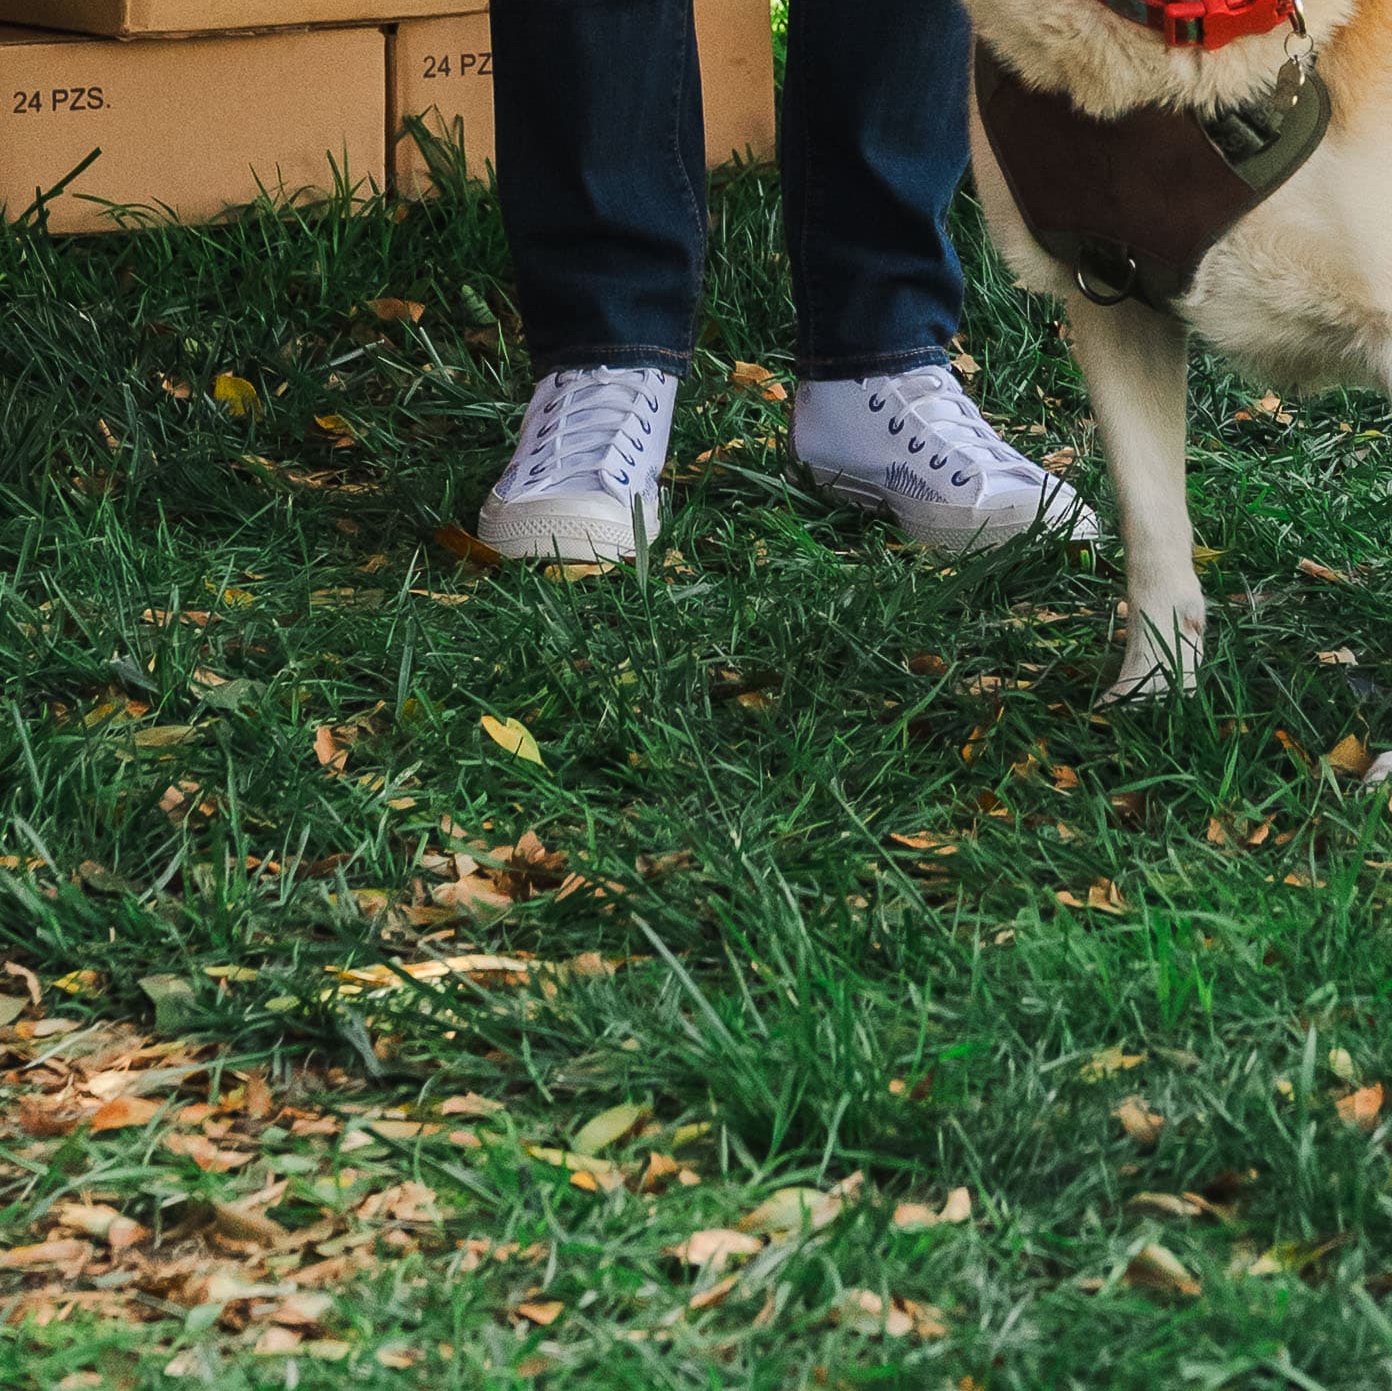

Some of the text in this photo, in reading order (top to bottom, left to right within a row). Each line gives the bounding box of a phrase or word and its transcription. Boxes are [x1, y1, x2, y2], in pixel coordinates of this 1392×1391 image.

[423, 53, 492, 78] 24 PZ
[12, 87, 112, 114] 24 PZS.
